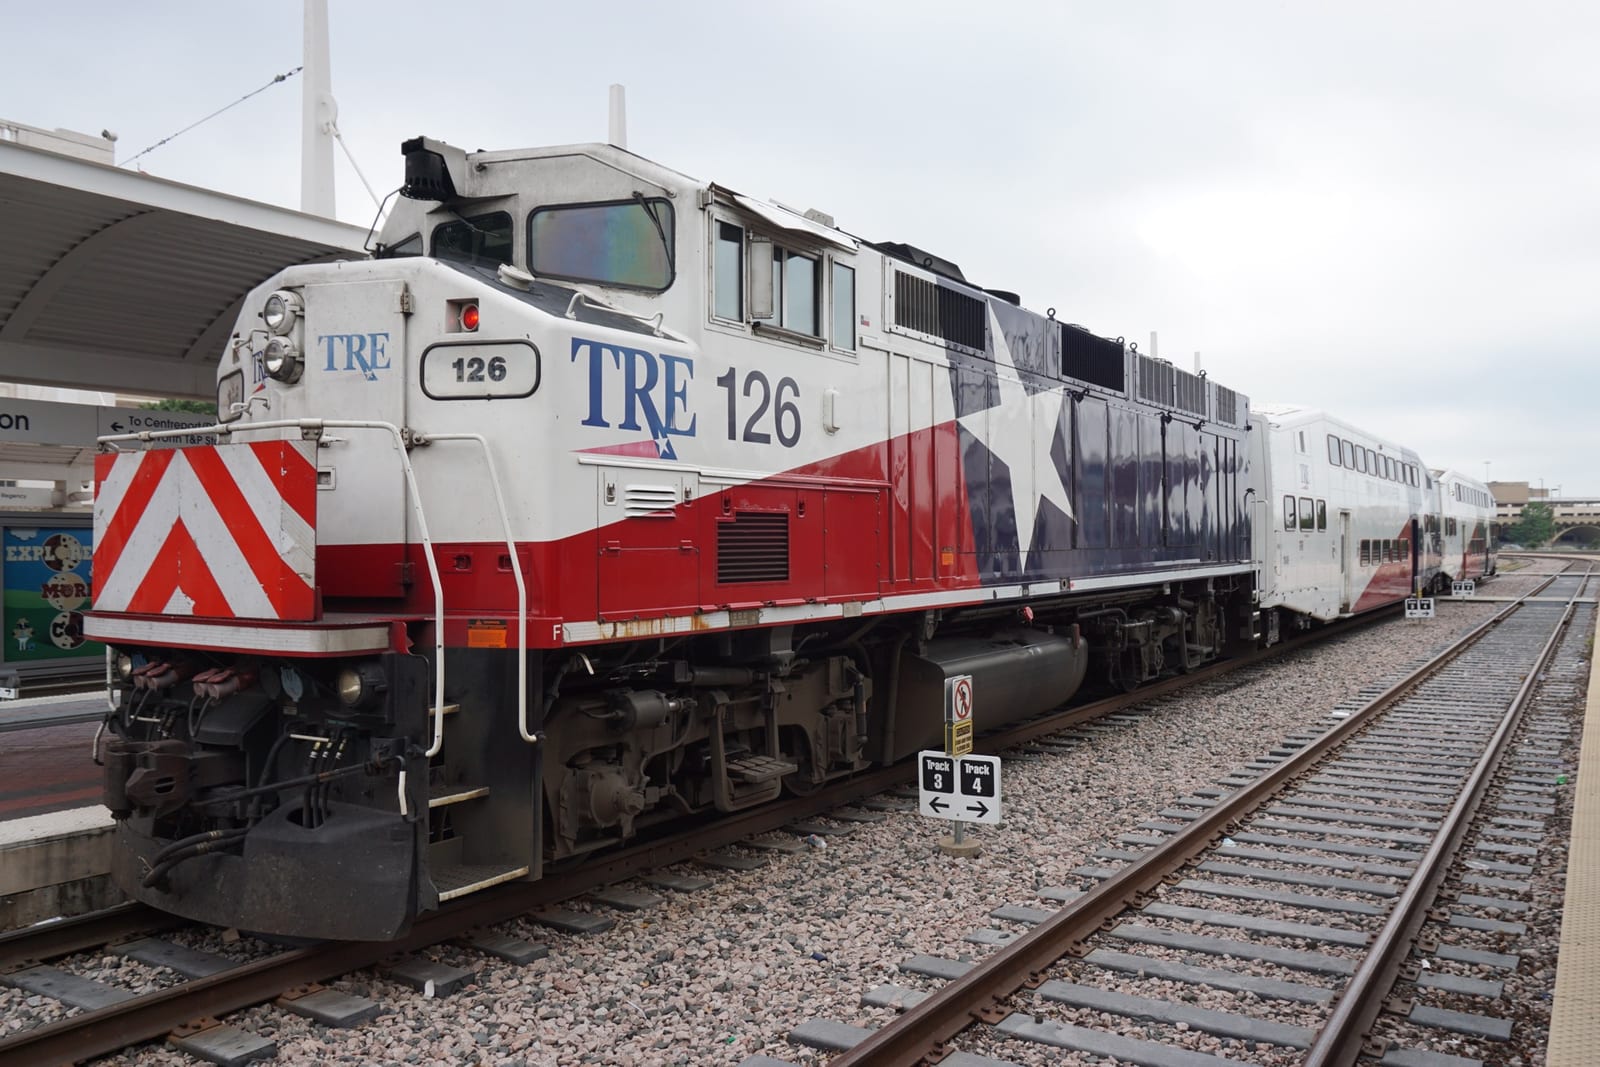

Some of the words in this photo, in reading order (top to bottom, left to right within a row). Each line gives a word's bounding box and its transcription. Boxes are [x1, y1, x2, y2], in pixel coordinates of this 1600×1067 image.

[318, 332, 391, 381] TRE
[452, 356, 507, 383] 126
[571, 337, 696, 460] TRE
[716, 366, 802, 449] 126
[0, 412, 30, 431] on
[128, 415, 141, 426] To
[185, 434, 202, 445] T&P
[552, 624, 562, 641] F
[926, 759, 950, 772] Track
[965, 763, 990, 775] Track
[934, 773, 943, 790] 3
[972, 777, 982, 793] 4
